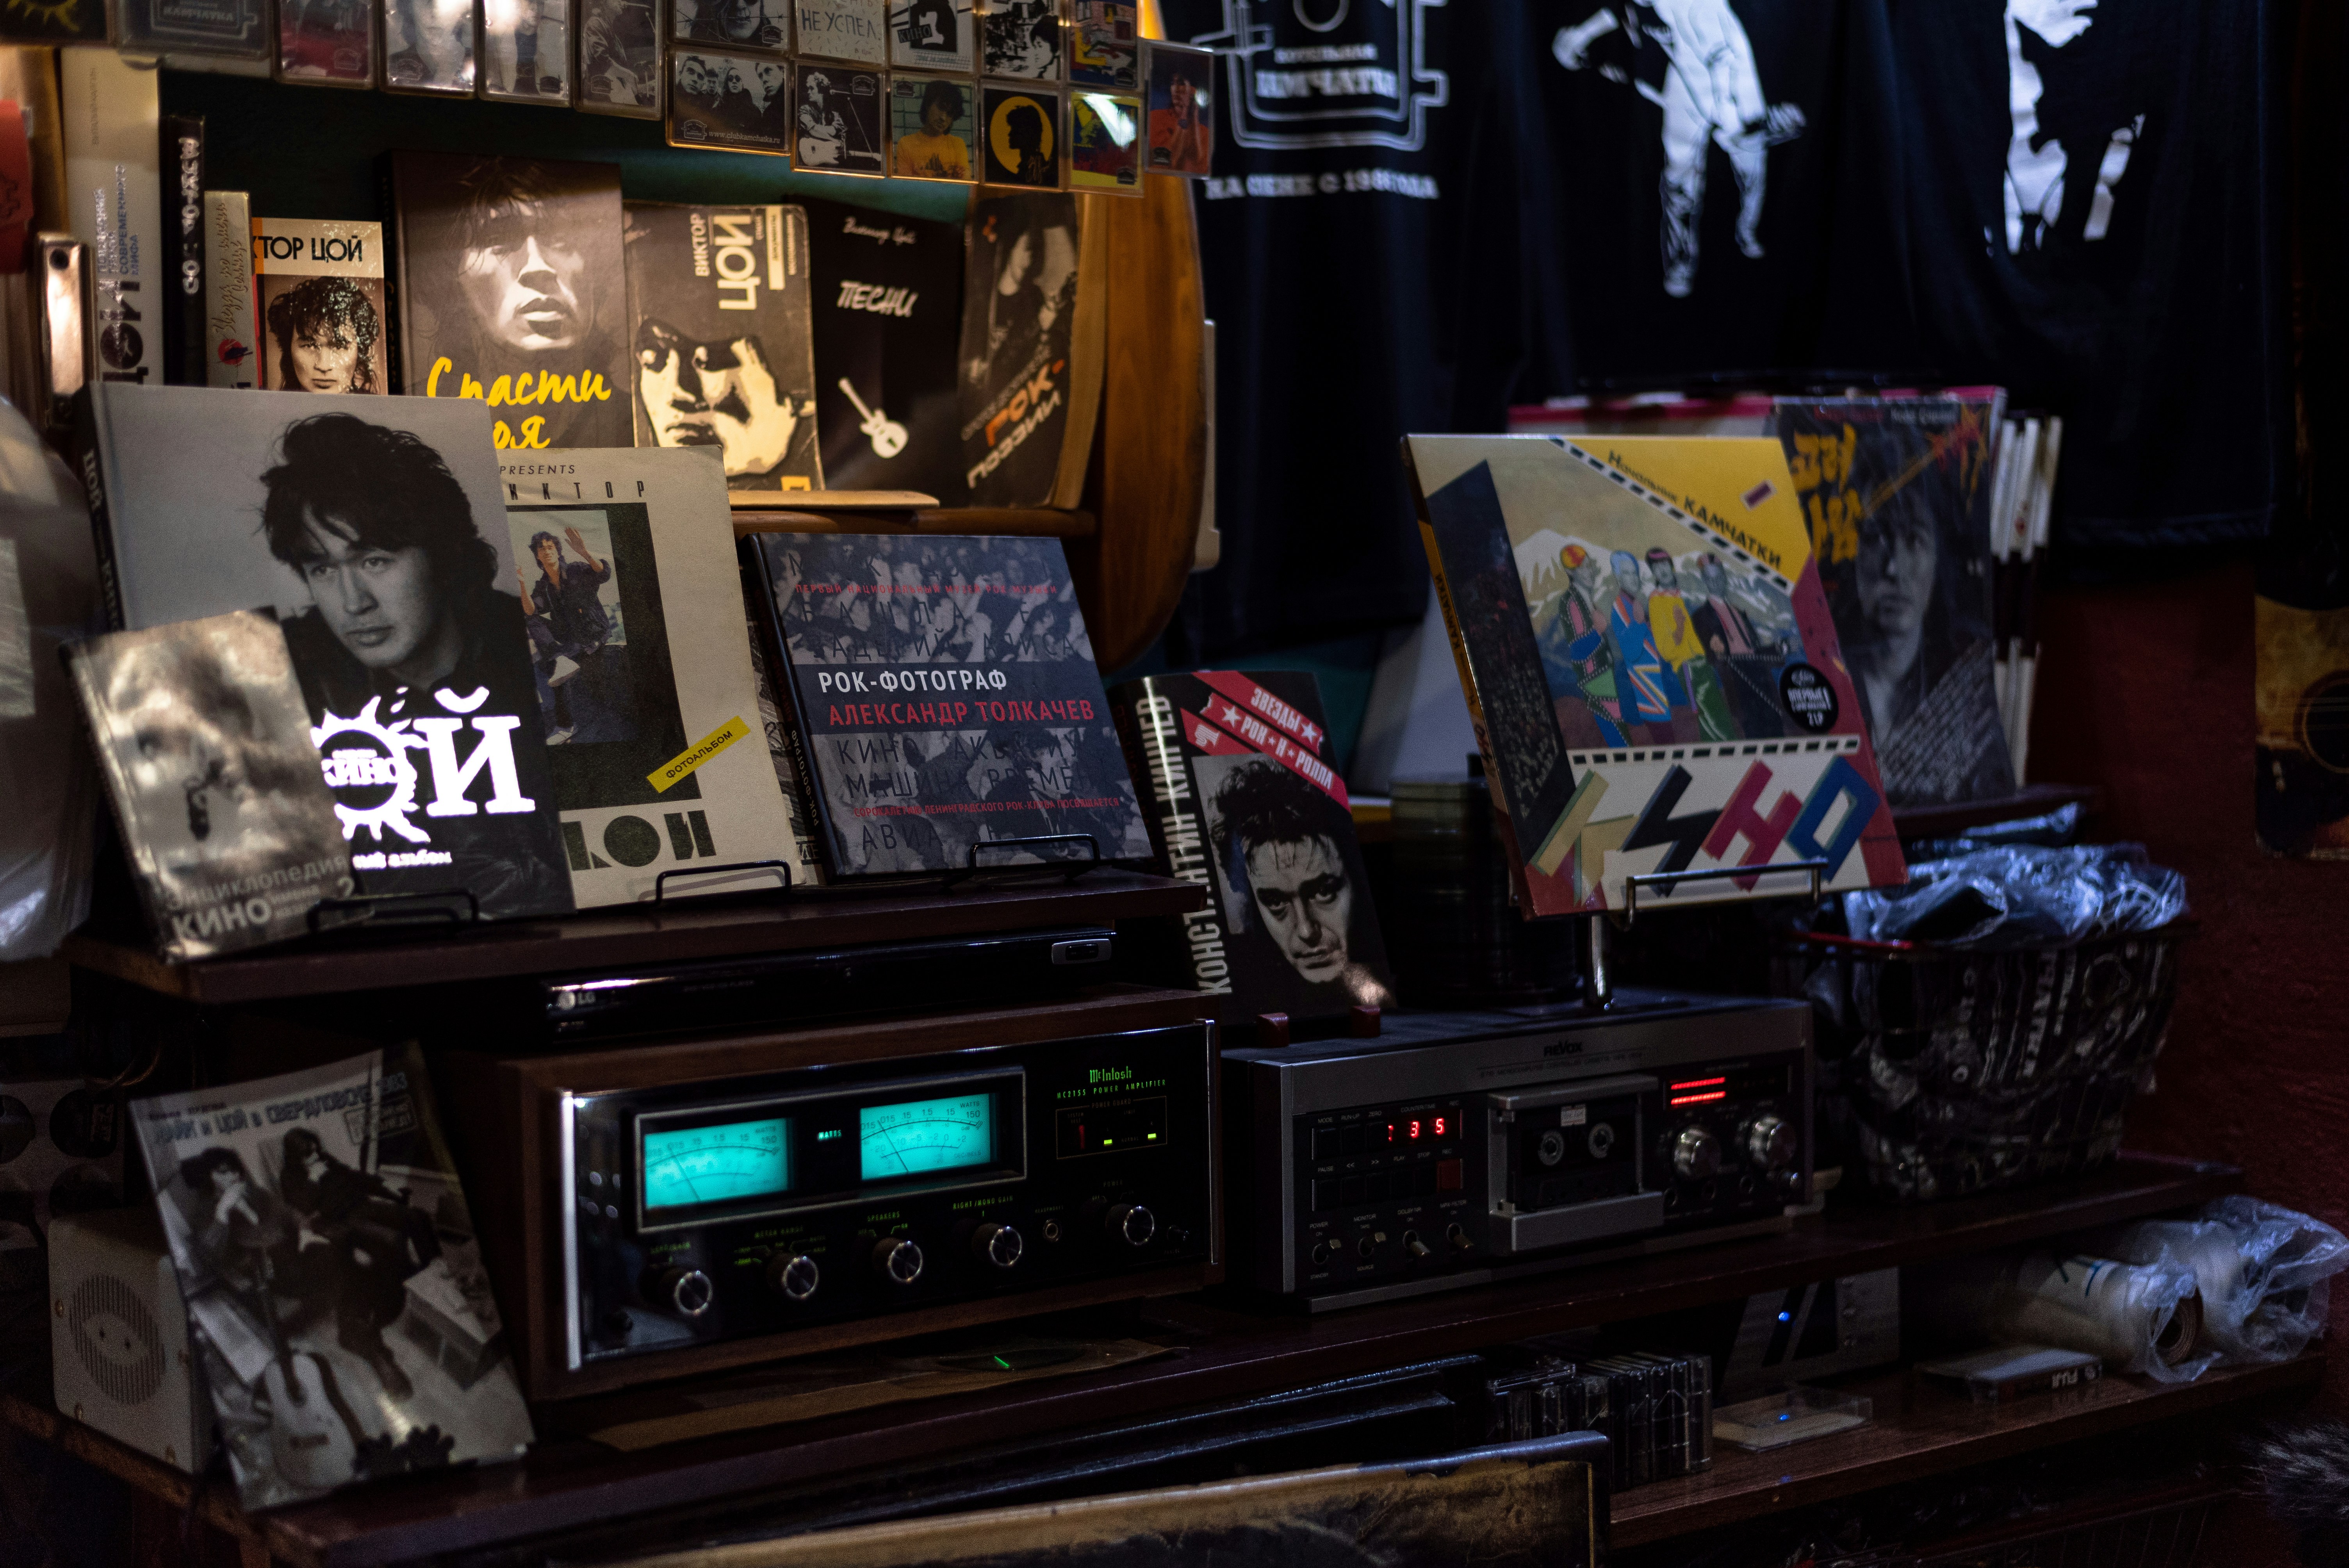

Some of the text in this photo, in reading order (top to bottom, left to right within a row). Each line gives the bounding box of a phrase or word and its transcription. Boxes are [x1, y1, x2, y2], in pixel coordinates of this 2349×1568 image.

[801, 8, 876, 39] НЕ УСПЕЛ
[899, 26, 931, 42] КИНО
[708, 131, 781, 144] www.clubkamchatka.ru
[310, 235, 363, 263] ЦОЙ
[690, 213, 710, 276] ВИКТОР
[708, 214, 761, 310] ЦОЙ
[836, 279, 919, 318] ПЕСНИ
[426, 356, 611, 406] Спасти
[499, 465, 576, 475] PRESENTS
[1683, 495, 1781, 568] КАМЧАТКИ
[795, 582, 842, 593] ПЕРВЫЙ
[1435, 571, 1463, 652] КАМЧАТКИ
[818, 668, 1007, 693] РОК-ФОТОГРАФ
[829, 699, 1094, 726] АЛЕКСАНДР ТОЛКАЧЕВ
[1250, 687, 1301, 730] ЗВЕЗДЫ
[665, 729, 733, 780] ФОТОАЛЬБОМ
[791, 729, 819, 828] РОК-ФОТОГРАФ
[925, 802, 1003, 815] ЛЕНИНГРАДСКОГО
[1007, 800, 1055, 811] РОК-КЛУБА
[1057, 797, 1120, 809] ПОСВЯЩАЕТСЯ
[172, 896, 273, 941] КИНО
[577, 991, 596, 1004] LG
[1089, 1065, 1132, 1084] McIntosh
[1057, 1079, 1166, 1099] MC2155 POWER AMPLIFIER
[946, 1108, 955, 1116] 15
[966, 1110, 981, 1119] 150
[1091, 1098, 1131, 1109] POWER GUARD
[216, 1109, 249, 1134] ЦОЙ
[818, 1130, 842, 1141] WATTS
[1103, 1179, 1123, 1188] POWER
[952, 1200, 973, 1211] RIGHT
[998, 1194, 1014, 1203] GAIN
[867, 1211, 900, 1223] SPEAKERS
[1309, 1221, 1328, 1229] POWER
[1353, 1213, 1376, 1222] MONITOR
